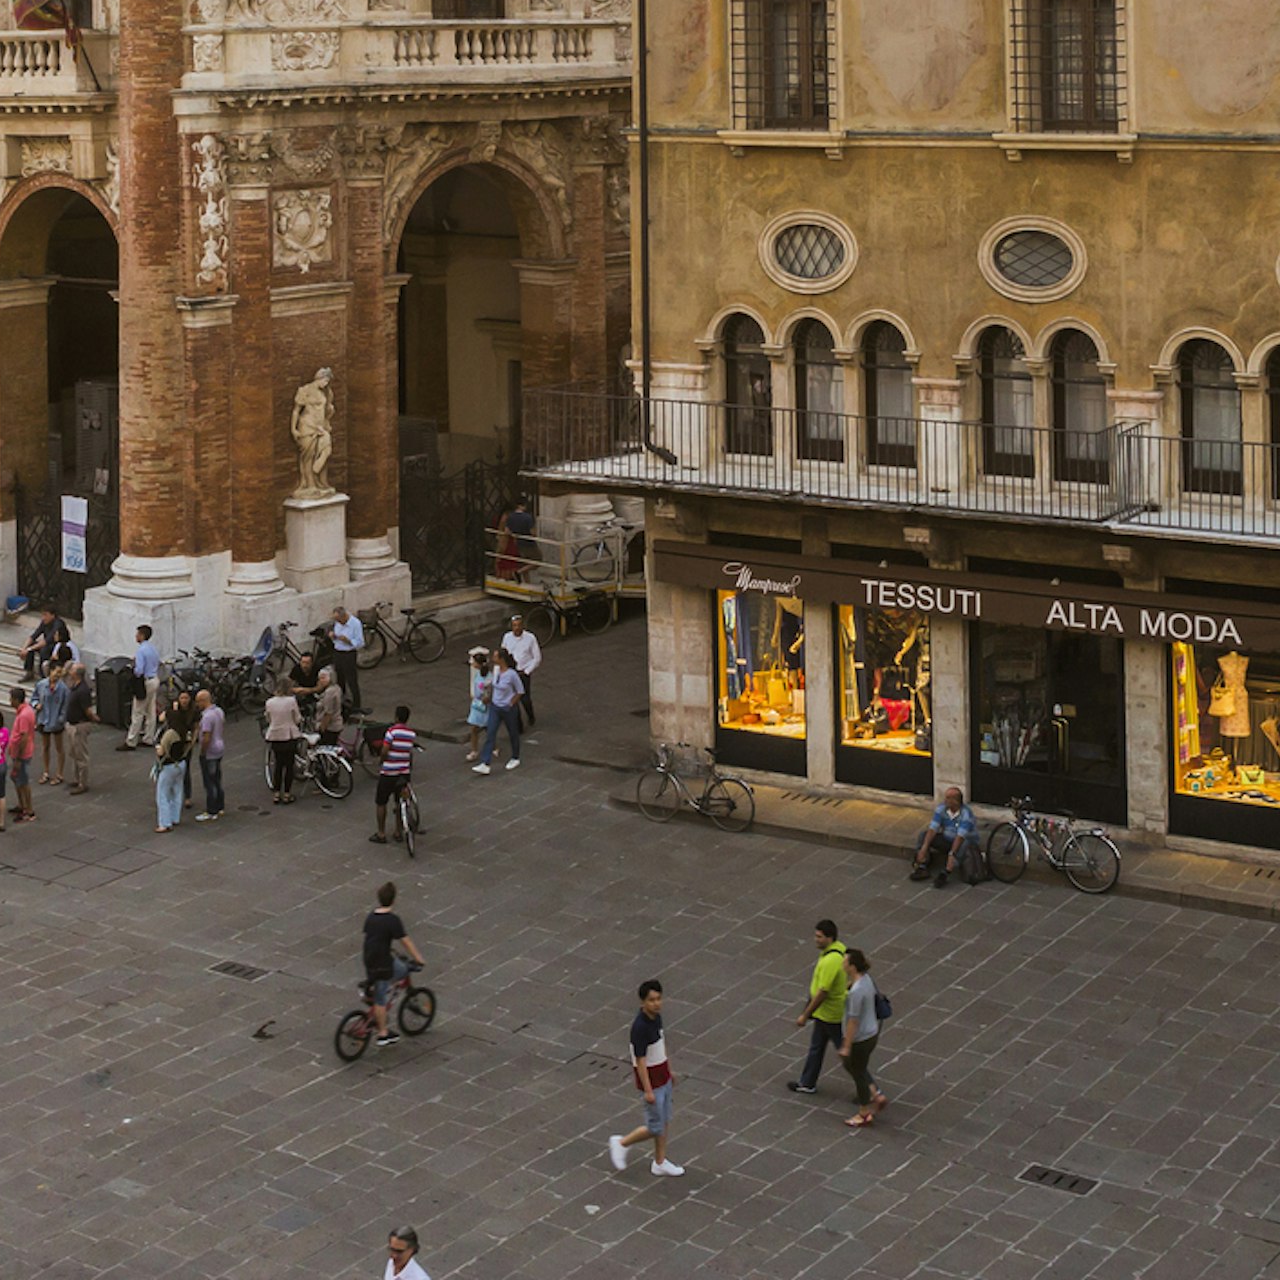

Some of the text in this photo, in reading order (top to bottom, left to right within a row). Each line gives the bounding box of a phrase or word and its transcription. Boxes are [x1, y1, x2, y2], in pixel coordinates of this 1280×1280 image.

[860, 578, 982, 617] TESSUTI
[1045, 599, 1243, 646] ALTA MODA
